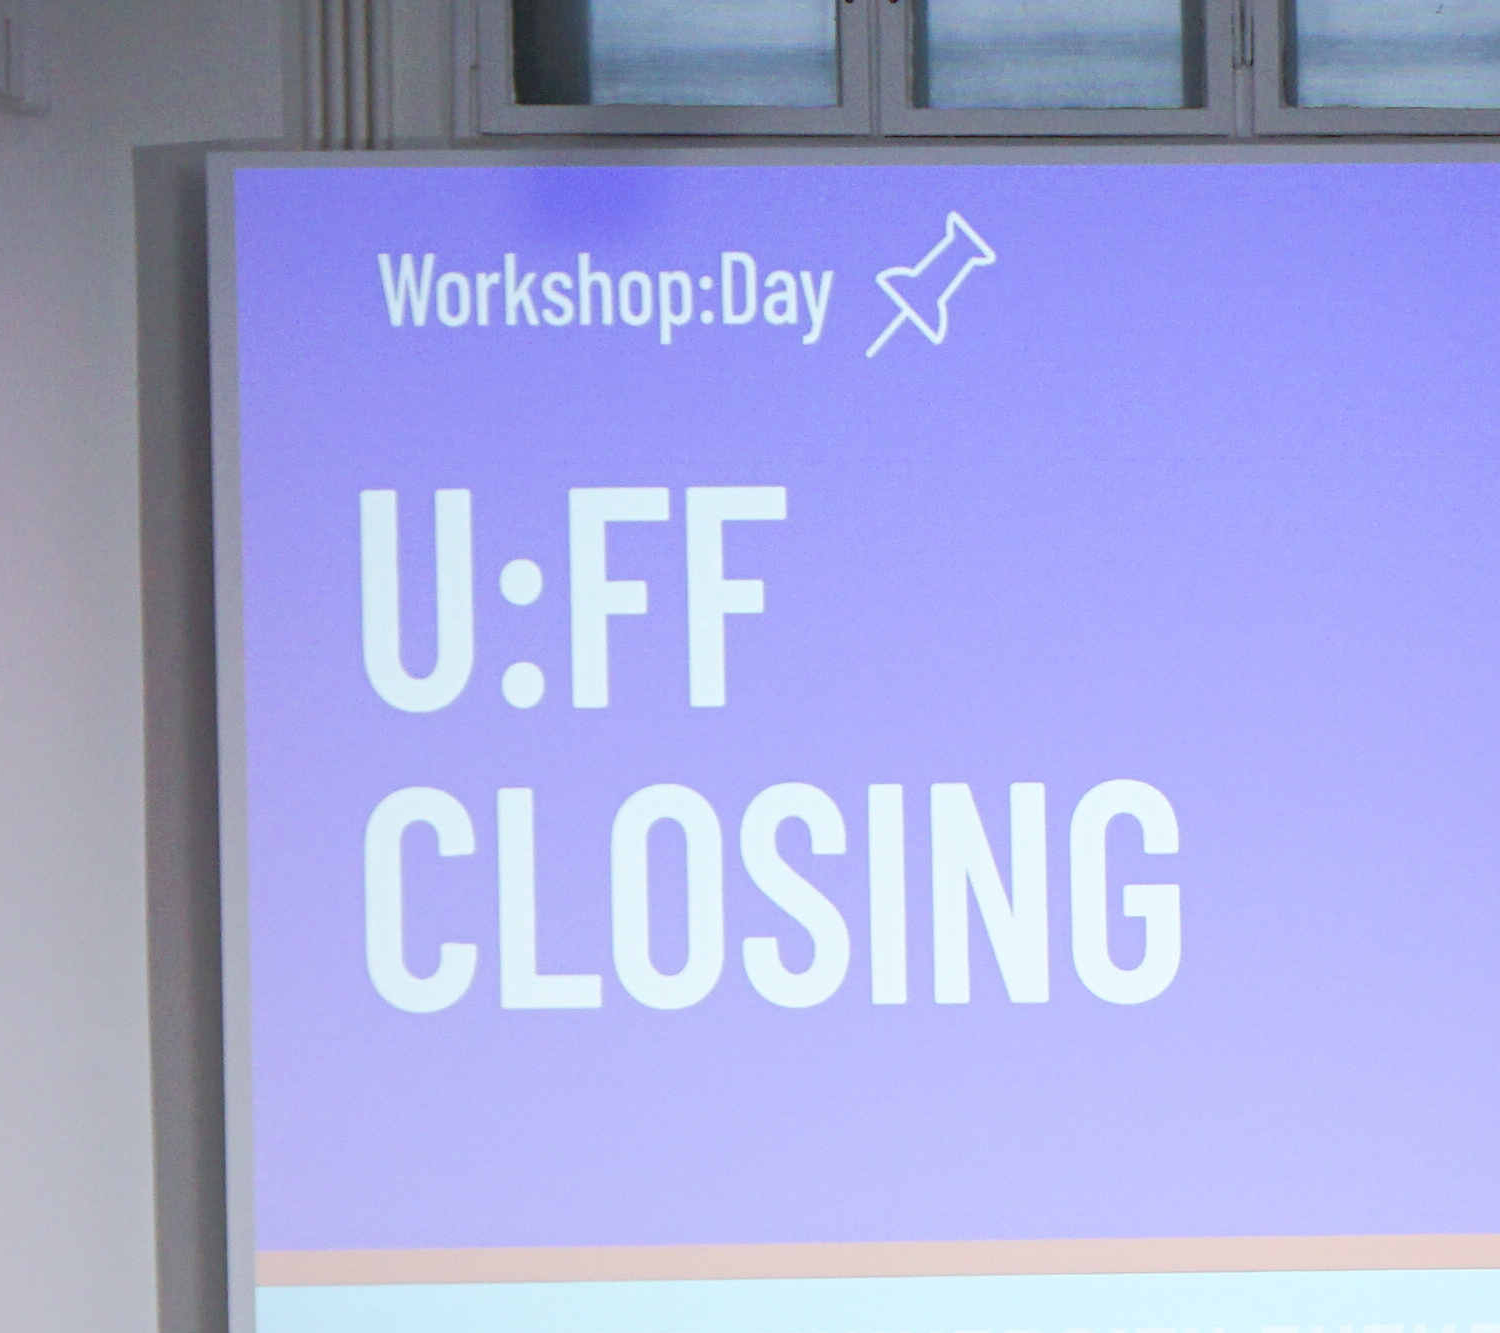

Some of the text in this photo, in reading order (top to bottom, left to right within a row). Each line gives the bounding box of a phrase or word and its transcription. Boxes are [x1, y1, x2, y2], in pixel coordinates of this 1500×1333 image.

[378, 250, 834, 346] Workshop:Day
[359, 485, 790, 714] U:FF
[362, 778, 1183, 1015] CLOSING
